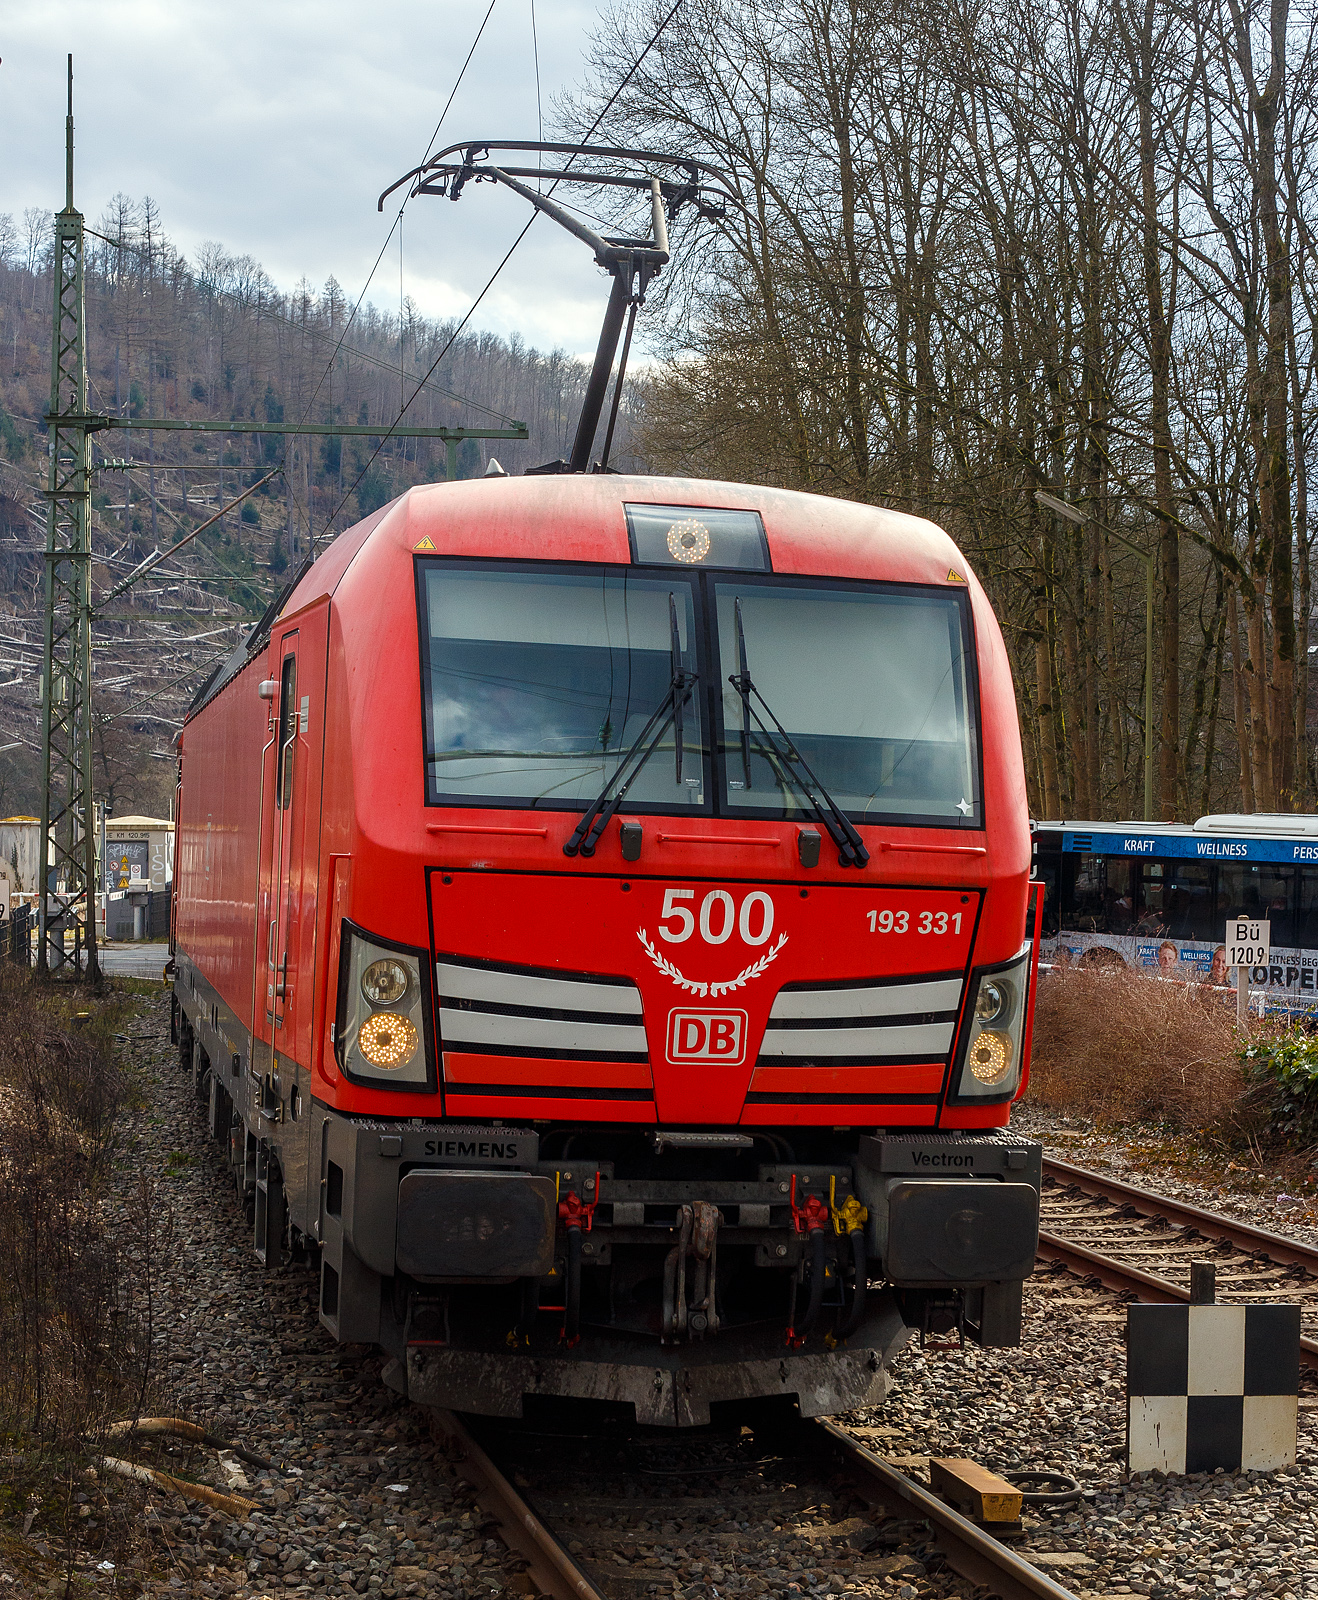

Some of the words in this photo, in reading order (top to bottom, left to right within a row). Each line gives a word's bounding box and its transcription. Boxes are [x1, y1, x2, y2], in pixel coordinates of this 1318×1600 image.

[1124, 839, 1155, 852] KRAFT
[1197, 843, 1248, 856] WELLNESS
[658, 888, 775, 946] 500
[866, 909, 909, 934] 193
[917, 911, 963, 936] 331
[1236, 923, 1260, 941] Bü
[1230, 946, 1265, 965] 120,9
[676, 1016, 737, 1056] DB
[424, 1140, 518, 1159] SIEMENS
[912, 1151, 974, 1167] Vectron
